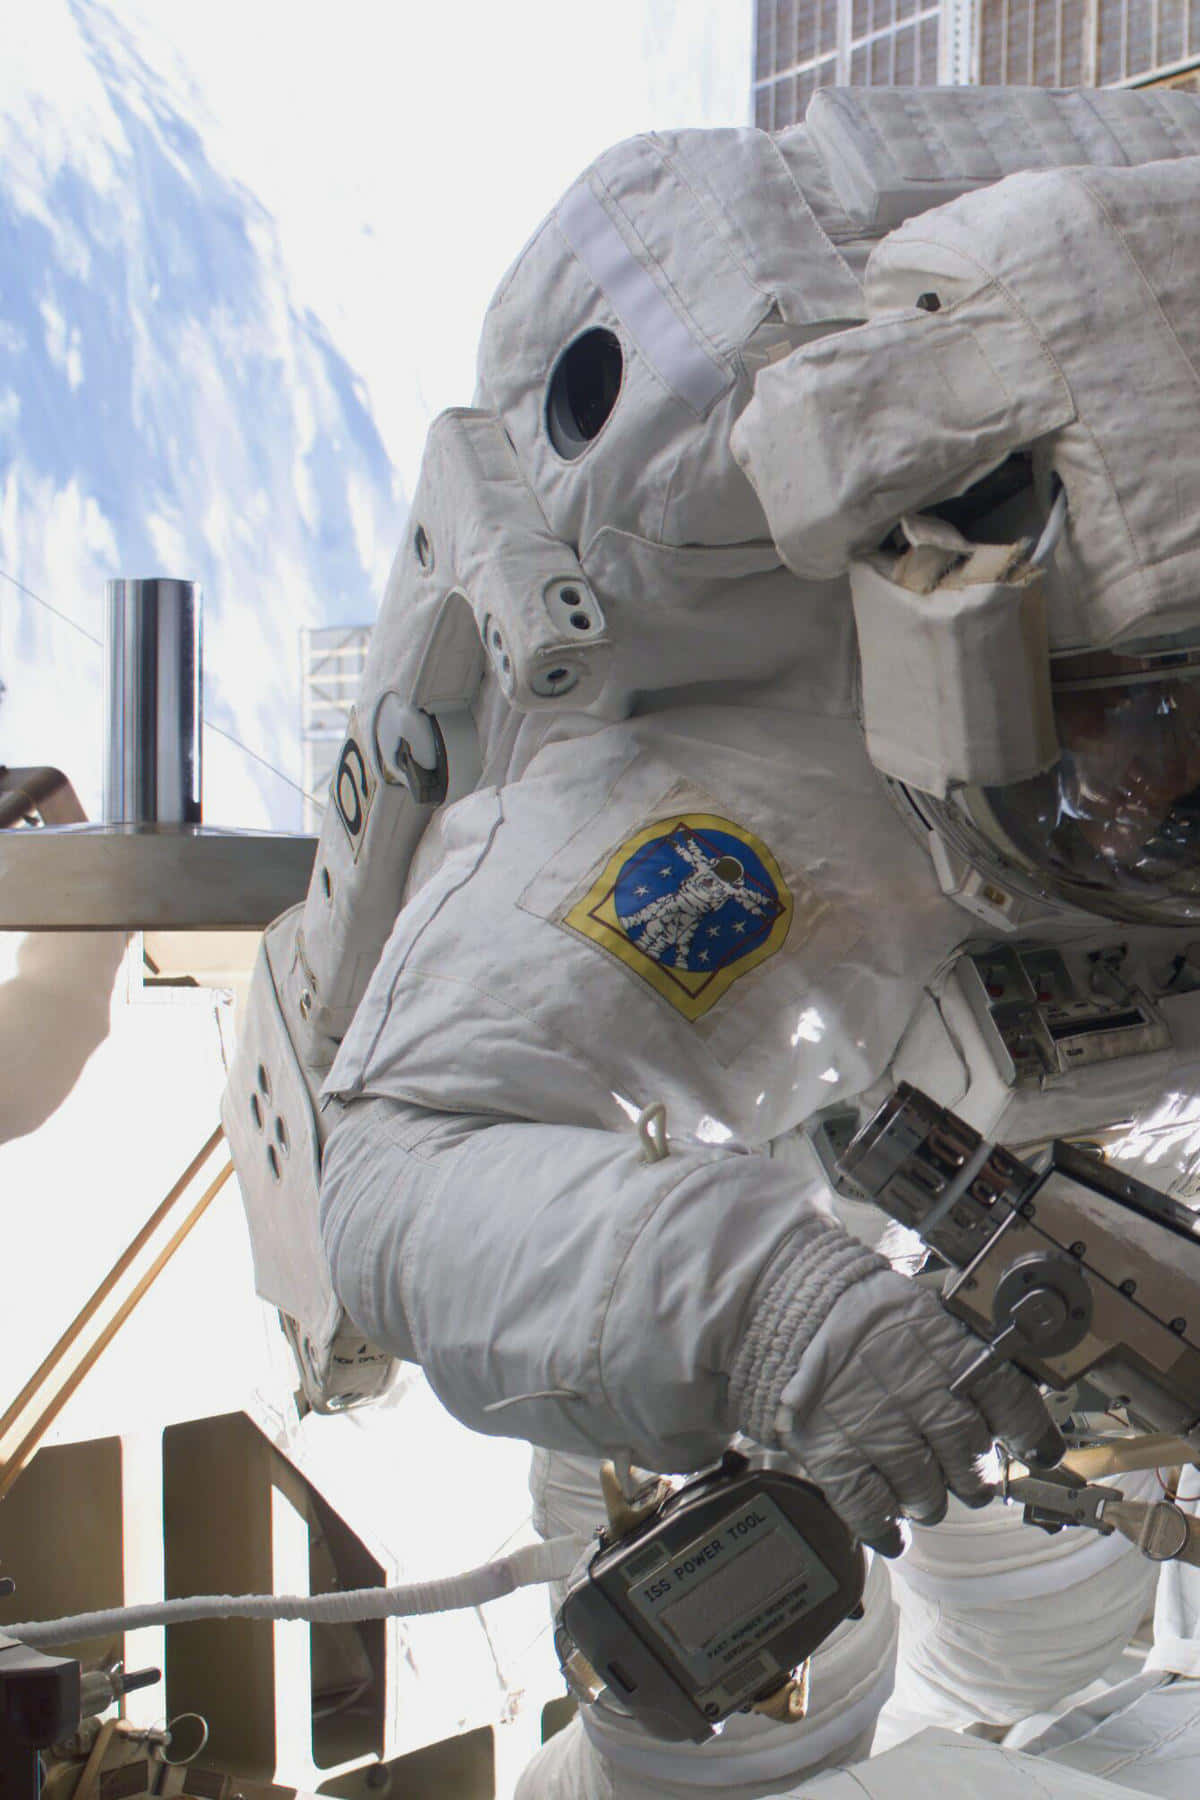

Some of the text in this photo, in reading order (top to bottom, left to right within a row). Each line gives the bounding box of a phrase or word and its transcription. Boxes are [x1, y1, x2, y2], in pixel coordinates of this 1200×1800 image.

[643, 1511, 767, 1603] ISS POWER TOOL
